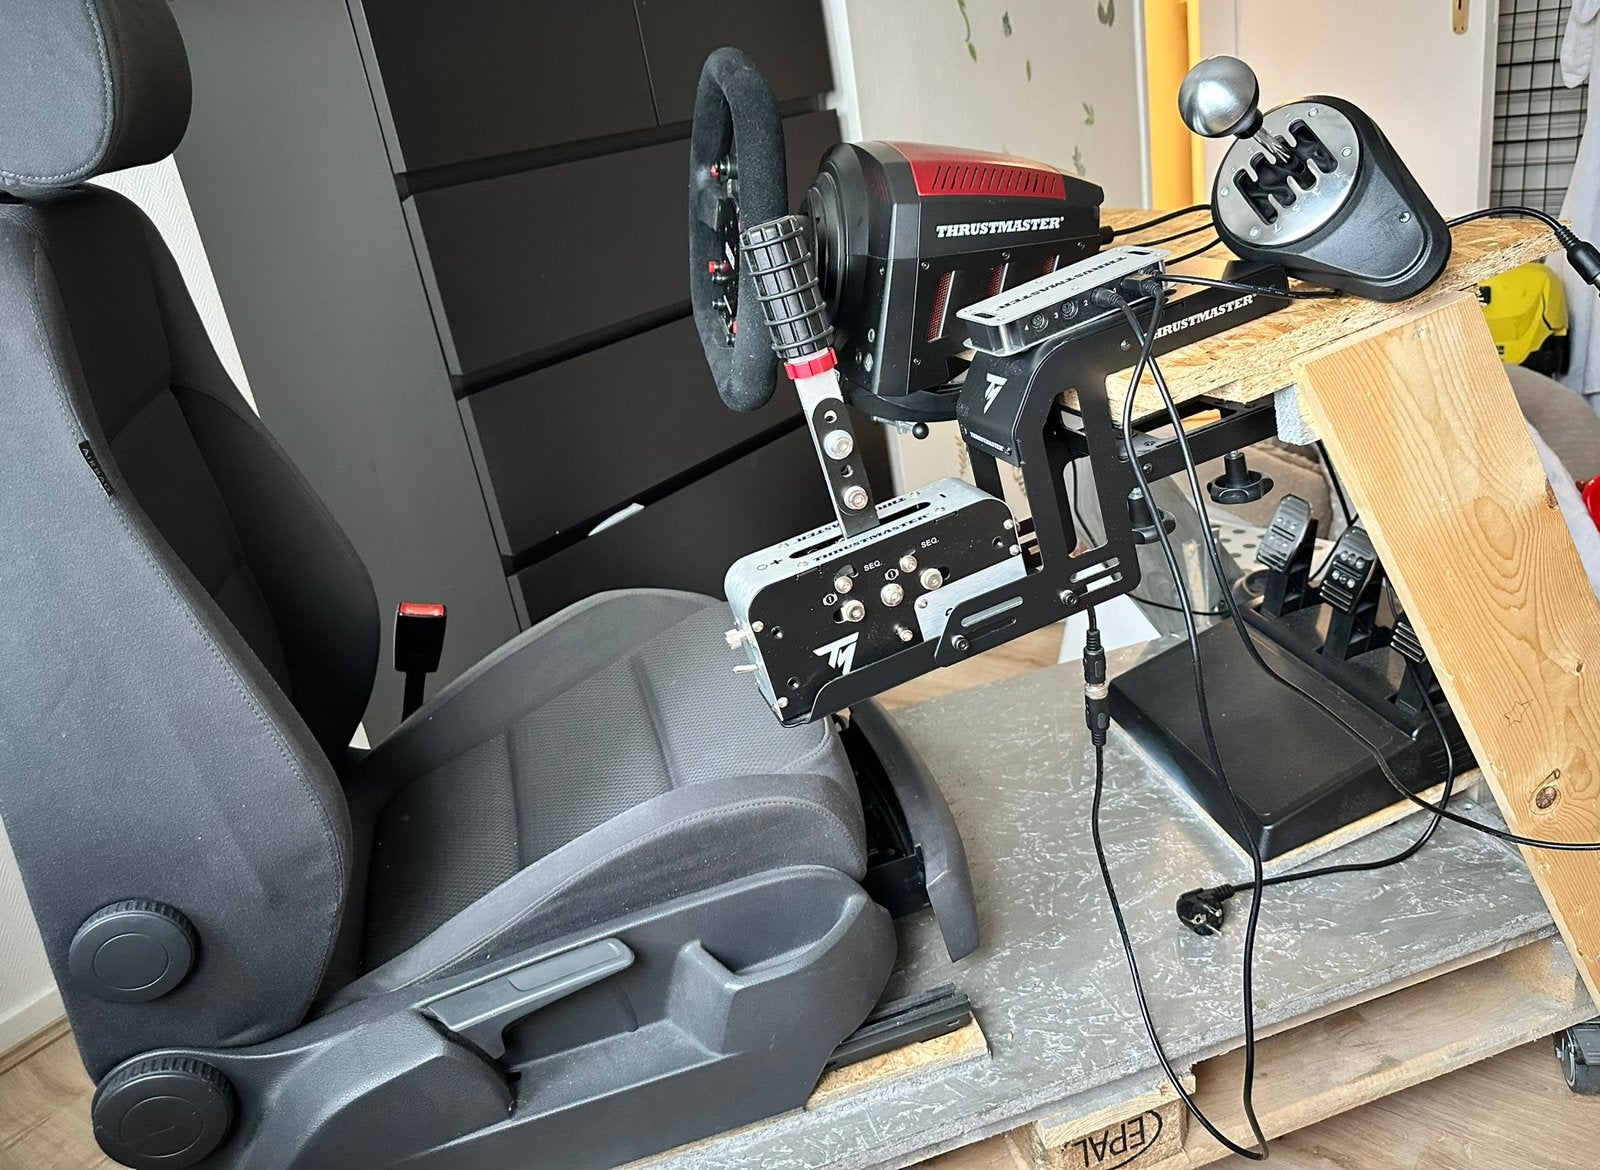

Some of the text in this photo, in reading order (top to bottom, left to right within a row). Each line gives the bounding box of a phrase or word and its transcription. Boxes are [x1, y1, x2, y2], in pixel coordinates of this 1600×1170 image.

[936, 217, 1061, 238] THRUSTMASTER
[1143, 294, 1255, 340] HRUSTMASTER
[1072, 1115, 1146, 1168] EPAL
